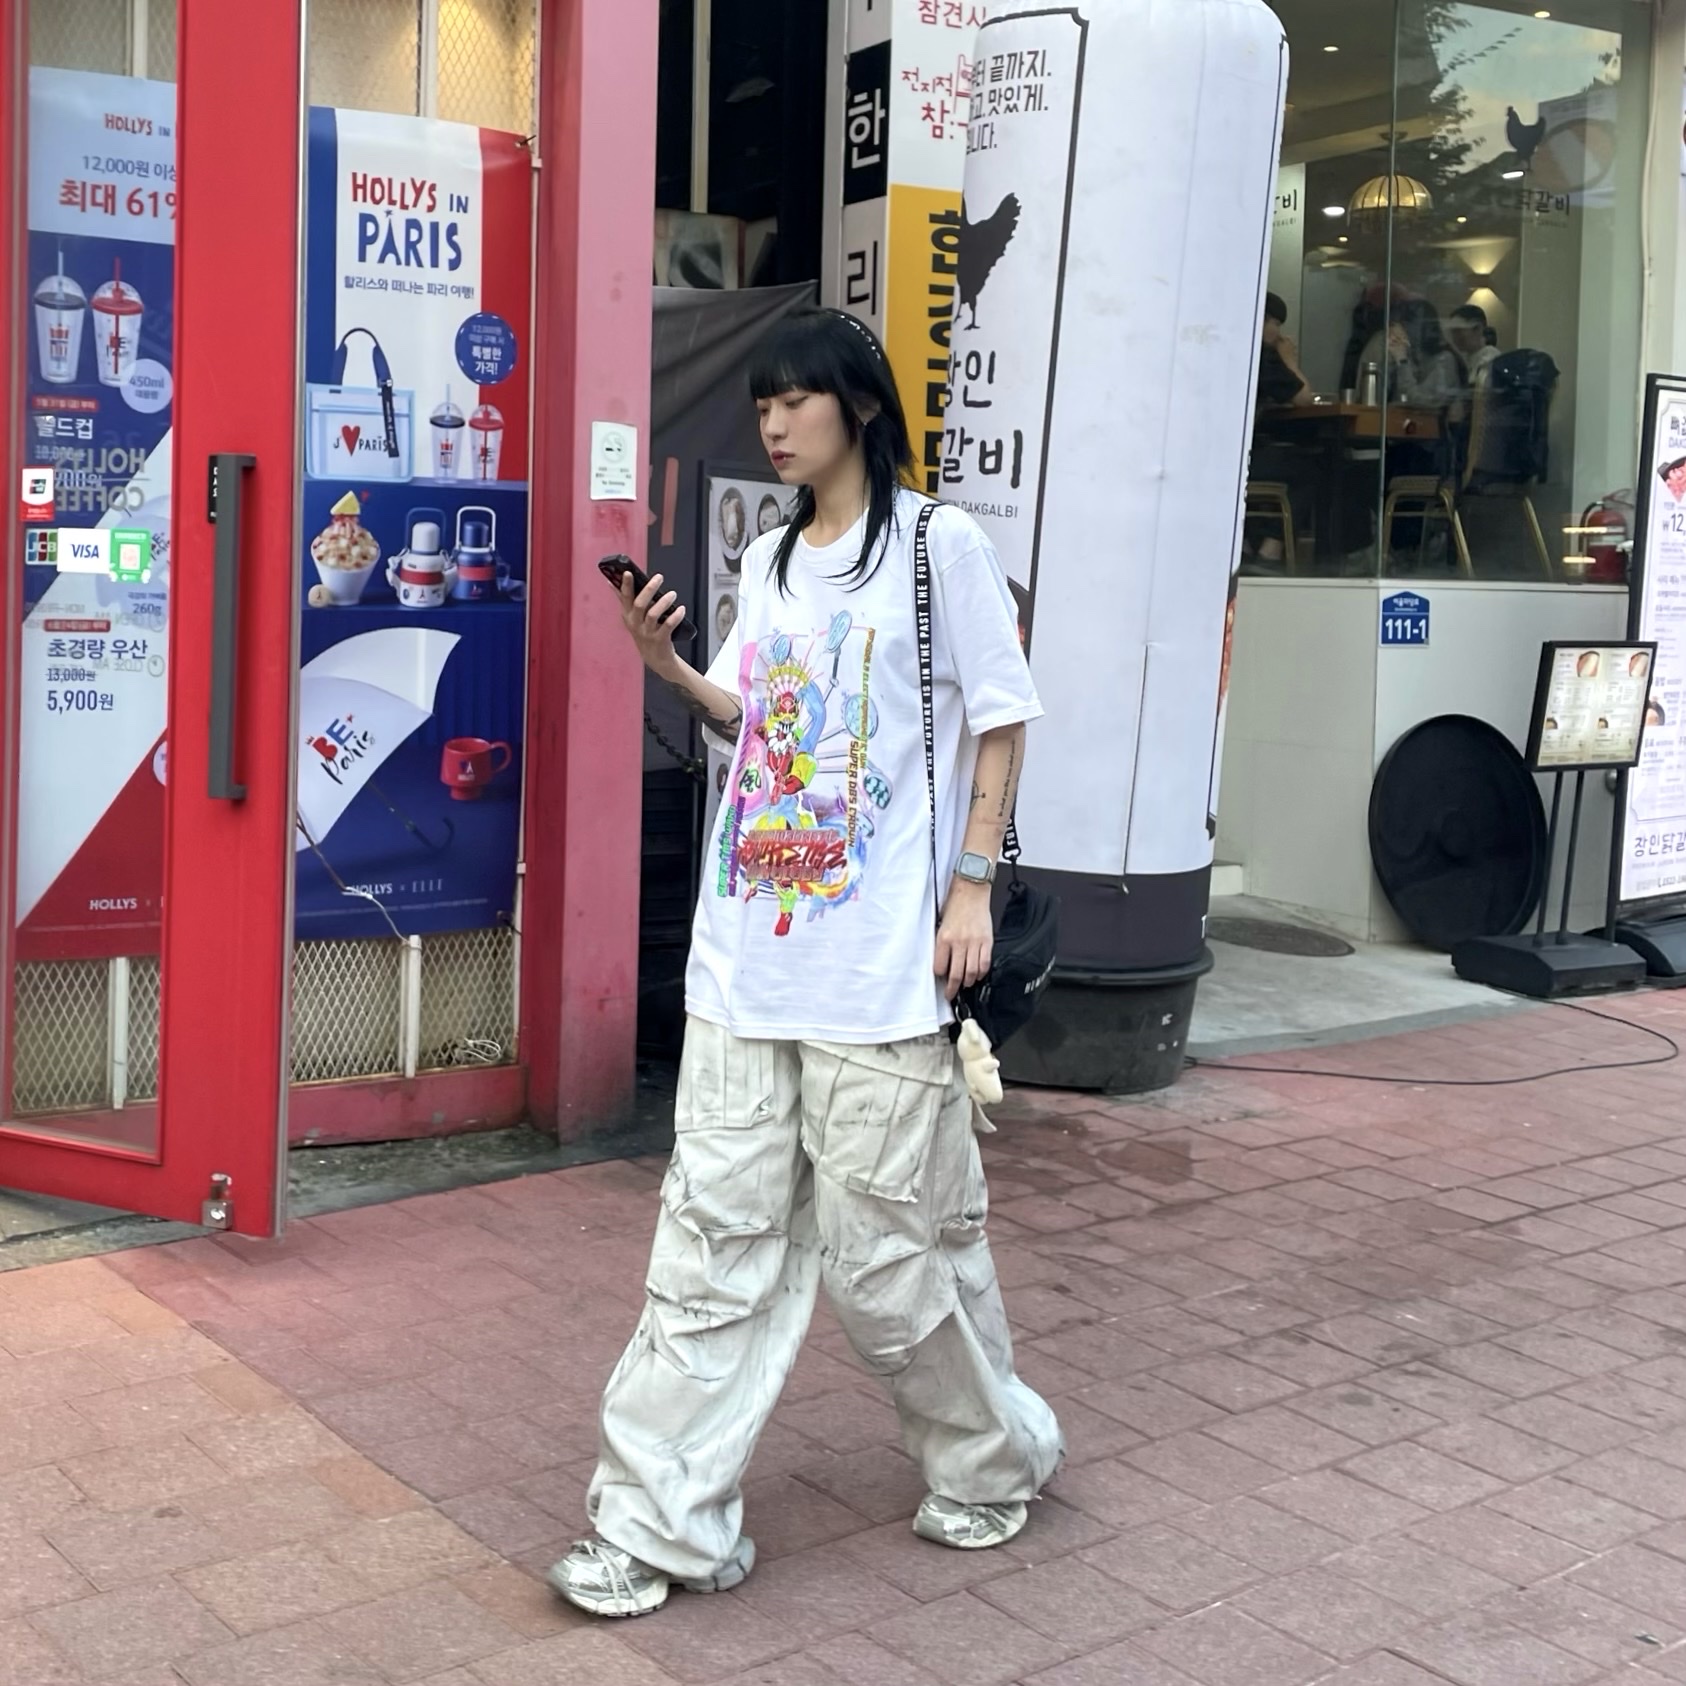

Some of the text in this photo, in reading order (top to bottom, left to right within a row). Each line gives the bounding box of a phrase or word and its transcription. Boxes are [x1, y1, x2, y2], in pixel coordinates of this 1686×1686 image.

[990, 49, 1051, 83] 끝까지.
[901, 67, 953, 97] 전지적
[988, 84, 1048, 116] 맛있게.
[104, 113, 171, 137] HOLLYS IN
[82, 156, 150, 178] 12,000원
[58, 179, 116, 216] 최대
[351, 172, 469, 214] HOLLYS IN
[358, 212, 462, 271] PARIS
[344, 275, 475, 300] 할리스와 떠나는 파리 여행!
[475, 361, 499, 376] 가격!
[918, 520, 928, 532] IS
[70, 543, 100, 559] VISA
[916, 536, 928, 578] FUTURE
[917, 585, 928, 604] THE
[132, 603, 163, 616] 260g
[918, 612, 930, 638] PAST
[1385, 618, 1427, 640] 111-1
[47, 638, 148, 661] 초경량 우산
[920, 643, 930, 664] THE
[921, 668, 931, 680] IN
[47, 689, 114, 716] 5,900원
[922, 685, 931, 696] IS
[923, 702, 932, 744] FUTURE
[848, 740, 860, 778] SUPER
[847, 807, 857, 849] CROWN
[717, 862, 730, 898] SUPER
[89, 897, 138, 911] HOLLYS
